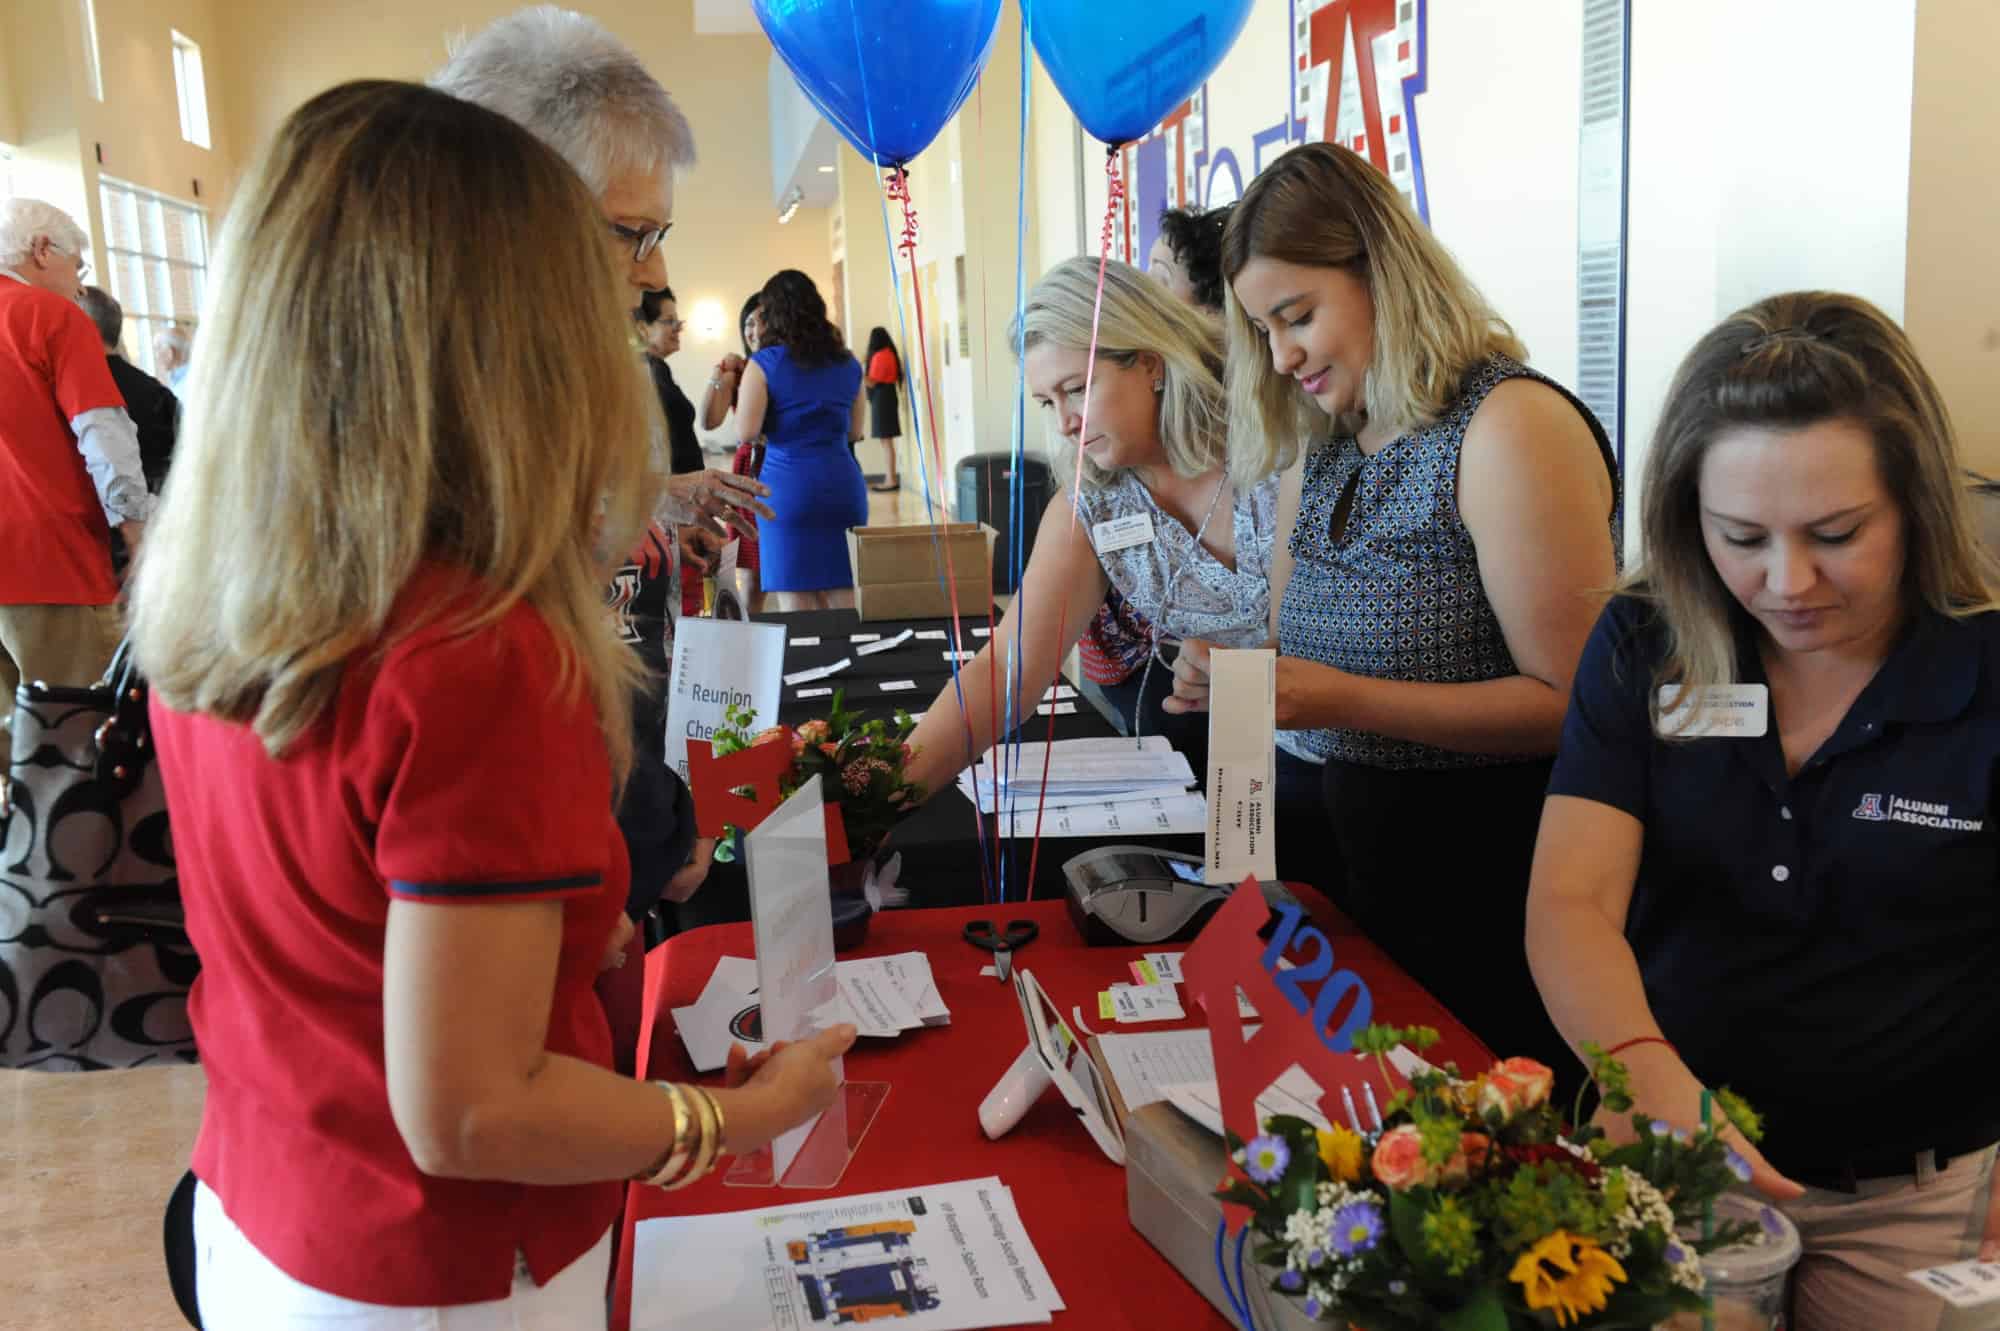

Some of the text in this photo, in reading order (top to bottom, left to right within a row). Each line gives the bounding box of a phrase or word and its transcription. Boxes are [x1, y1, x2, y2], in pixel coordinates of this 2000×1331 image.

[692, 684, 752, 706] Reunion
[1894, 797, 1949, 816] ALUMNI
[1248, 802, 1256, 855] ASSOCIATION
[1892, 810, 1983, 831] ASSOCIATION
[1260, 899, 1373, 1054] 120
